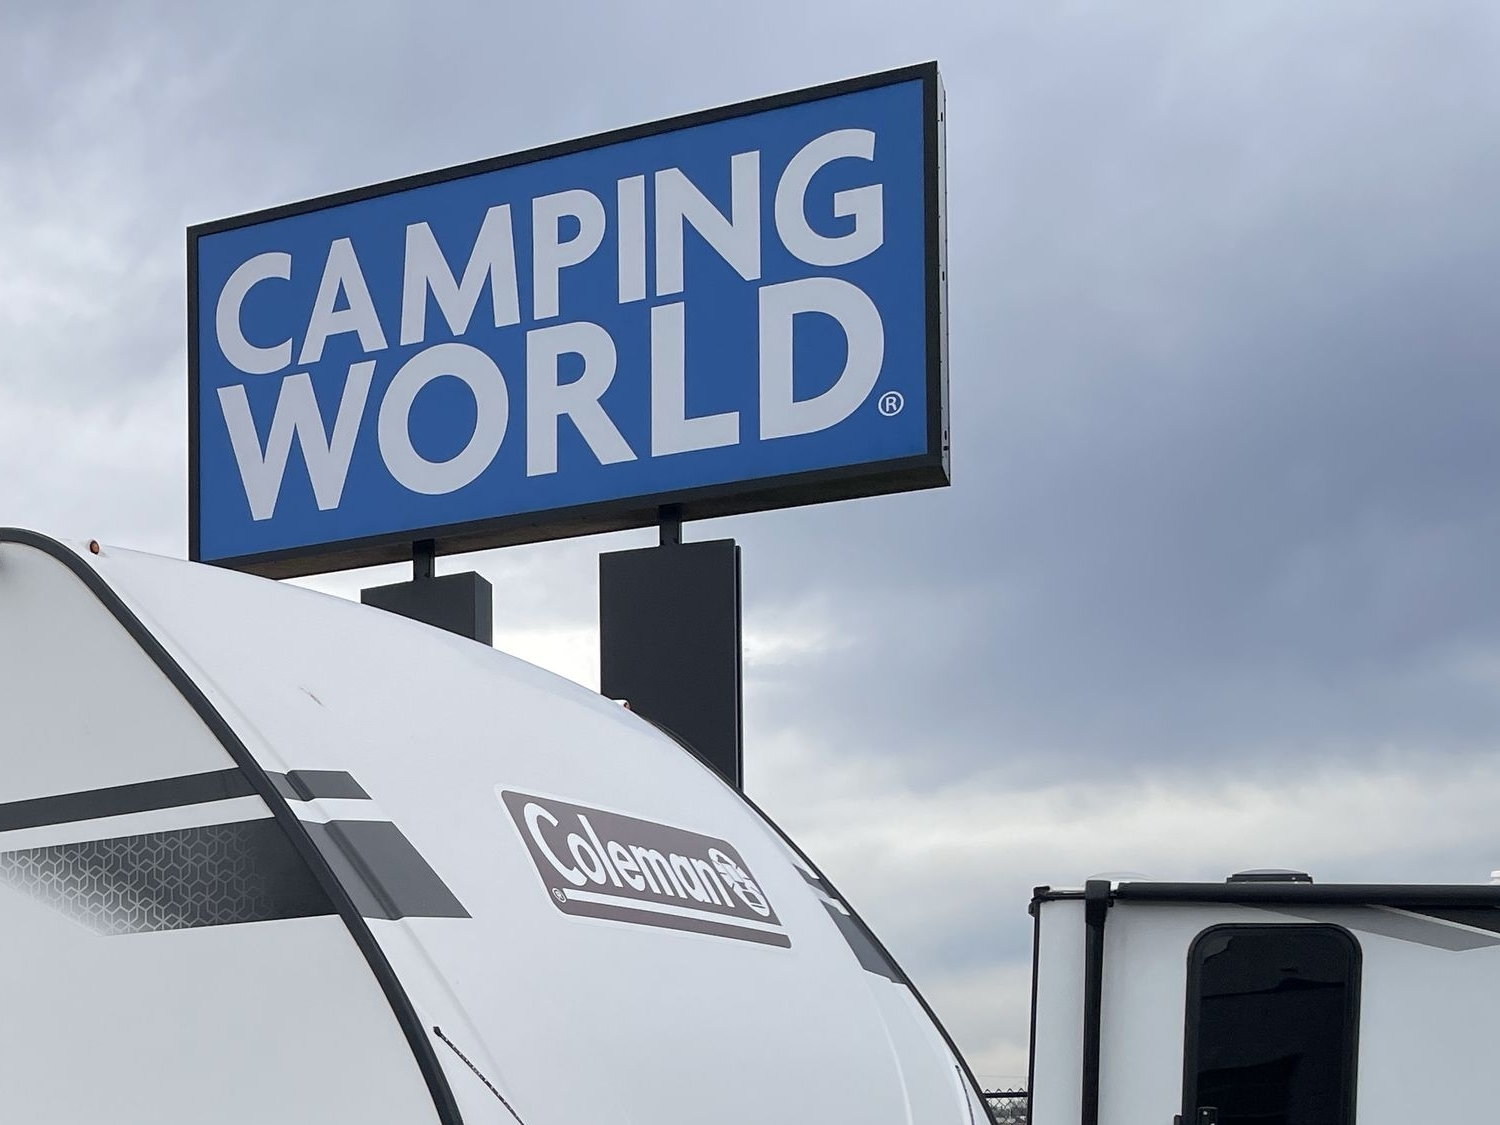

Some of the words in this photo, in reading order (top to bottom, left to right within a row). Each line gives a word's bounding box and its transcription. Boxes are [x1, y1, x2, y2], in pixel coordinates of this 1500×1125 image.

[215, 128, 884, 375] CAMPING
[216, 276, 885, 522] WORLD
[523, 802, 736, 908] Coleman
